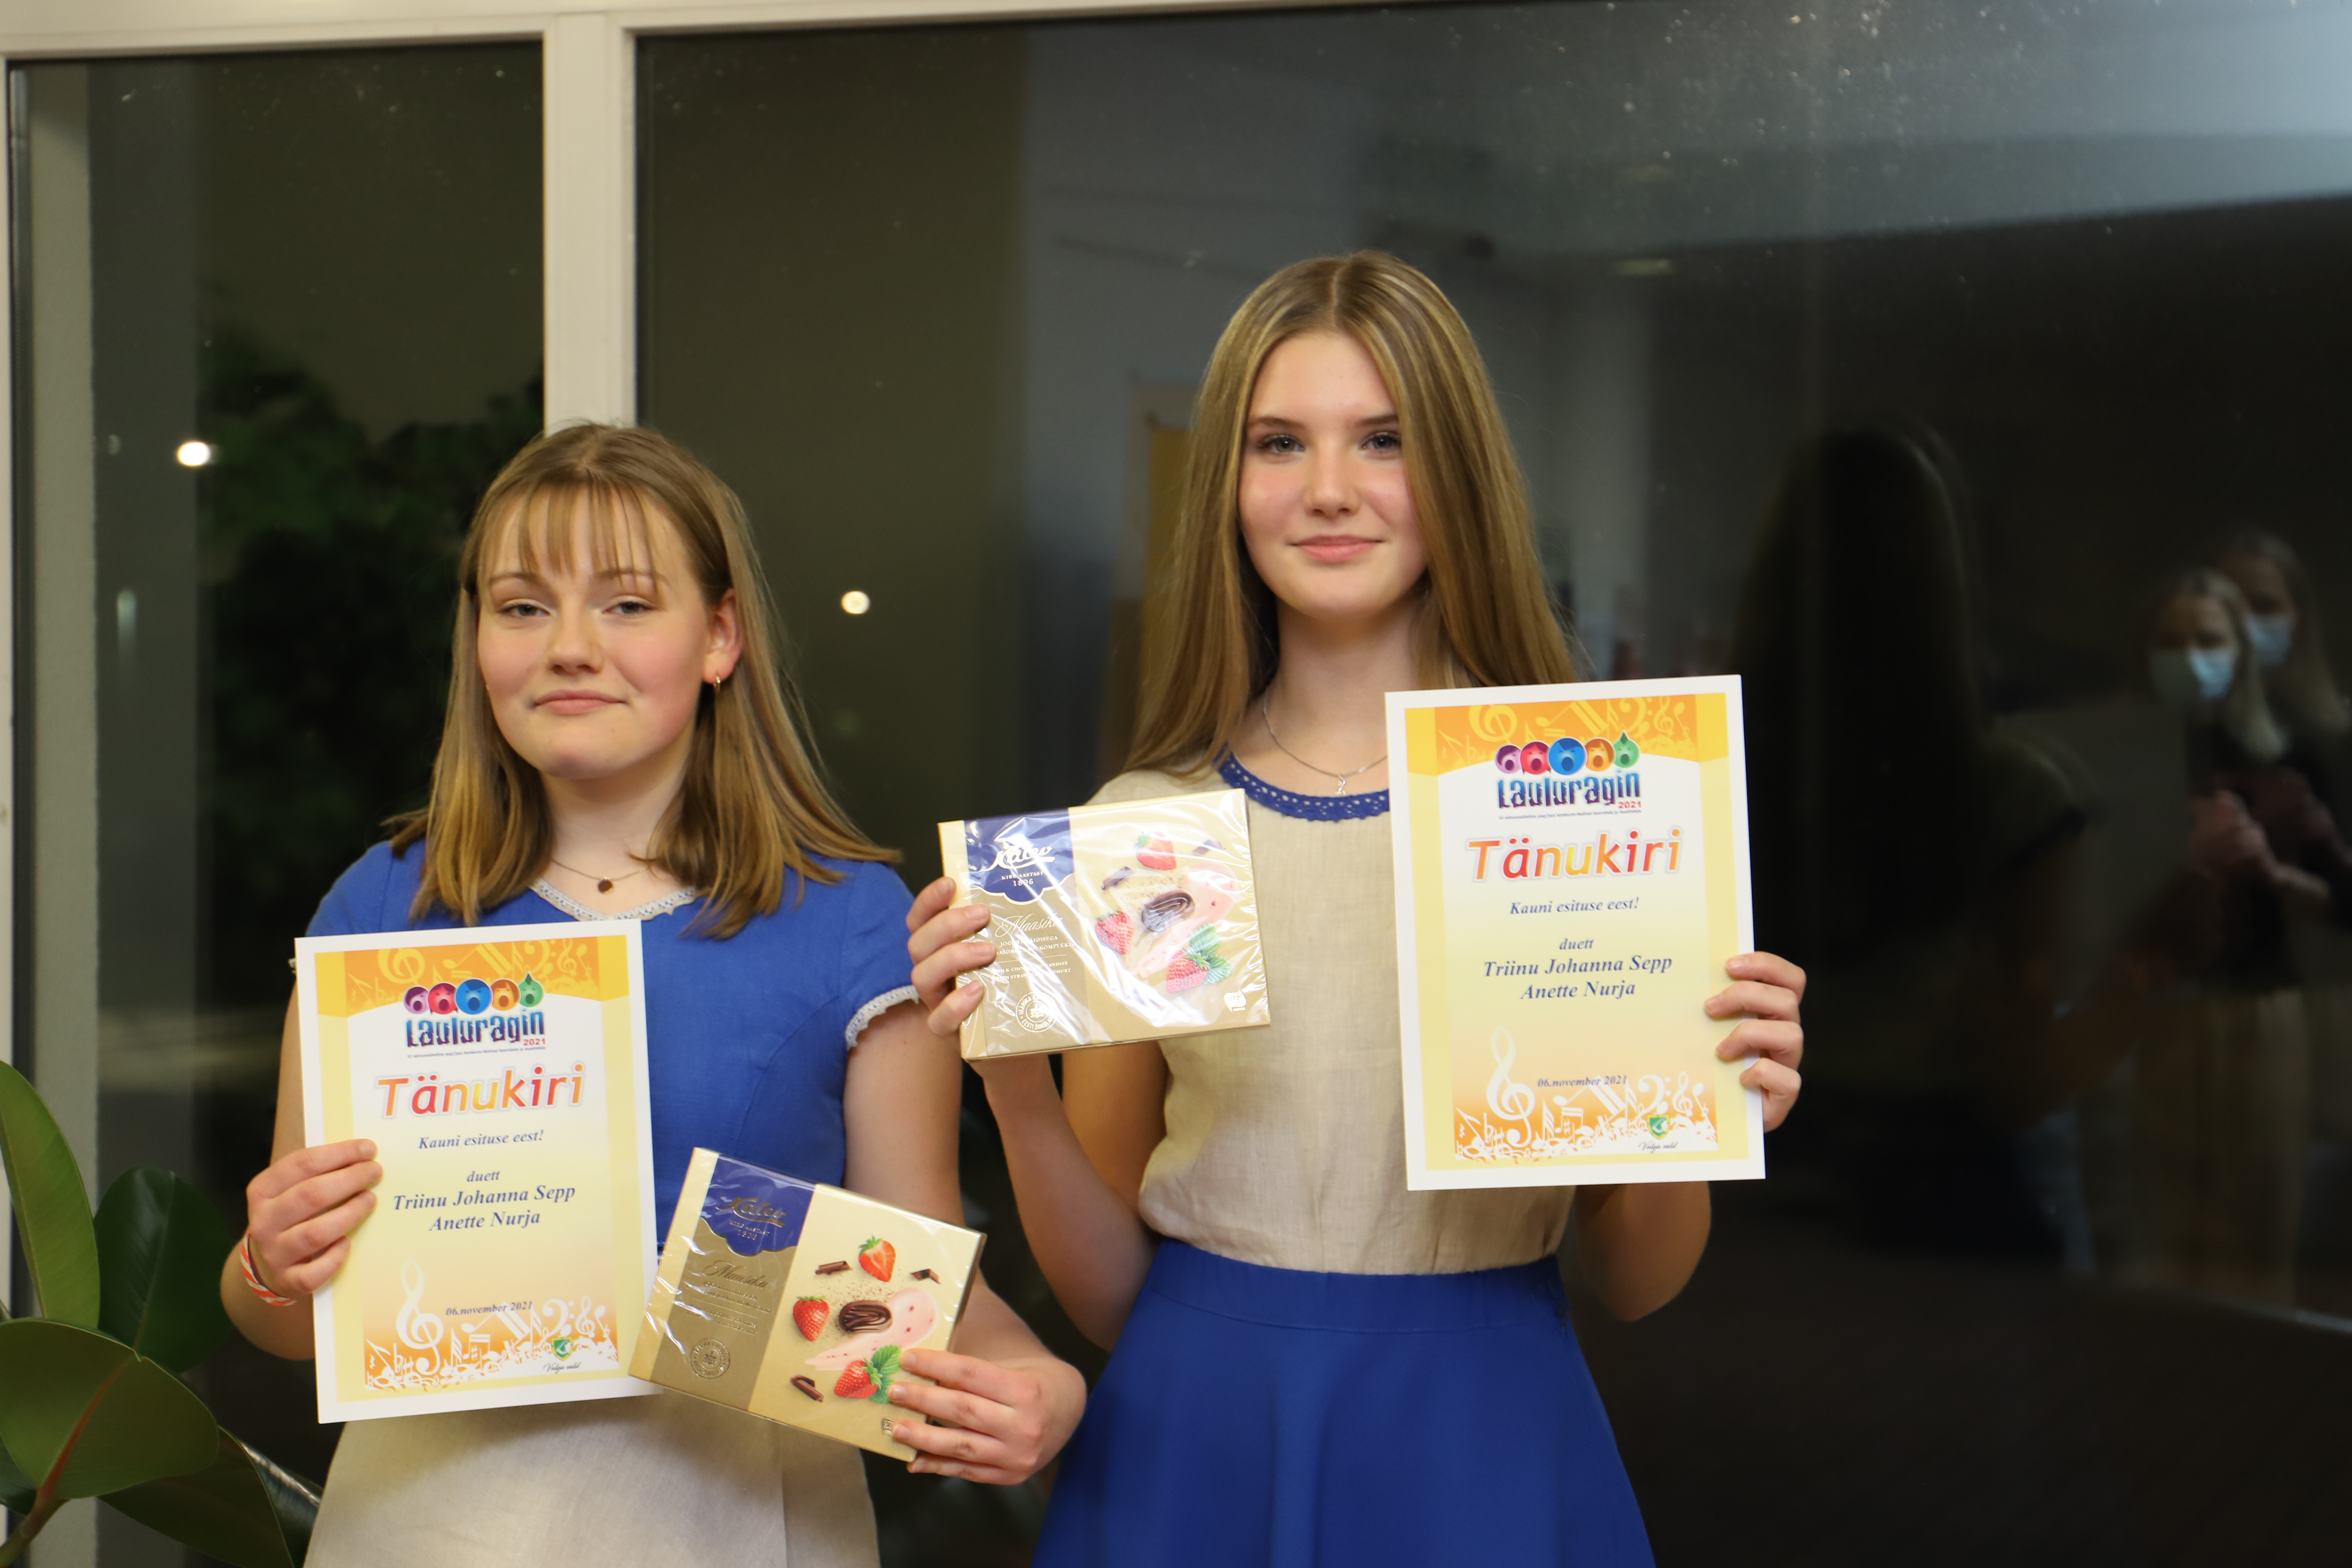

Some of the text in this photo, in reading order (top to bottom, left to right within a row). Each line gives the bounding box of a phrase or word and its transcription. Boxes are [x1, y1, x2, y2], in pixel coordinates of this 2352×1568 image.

[1618, 801, 1642, 809] 2021
[982, 844, 1056, 871] Kalev
[1468, 828, 1681, 880] Tänukiri
[1510, 897, 1640, 915] Kauni esituse eest!
[1559, 937, 1594, 951] duett
[1484, 955, 1673, 977] Triinu Johanna Sepp
[1520, 981, 1637, 1000] Anette Nurja
[1021, 1018, 1035, 1030] EESTI
[523, 1038, 546, 1046] 2021
[377, 1063, 584, 1117] Tänukiri
[1537, 1075, 1628, 1087] 06.november 2021
[418, 1130, 544, 1150] Kauni esituse eest!
[466, 1170, 500, 1183] duett
[394, 1186, 576, 1211] Triinu Johanna Sepp
[429, 1211, 541, 1232] Anette Nurja
[715, 1196, 787, 1228] Kalev
[445, 1301, 533, 1316] 06.november 2021
